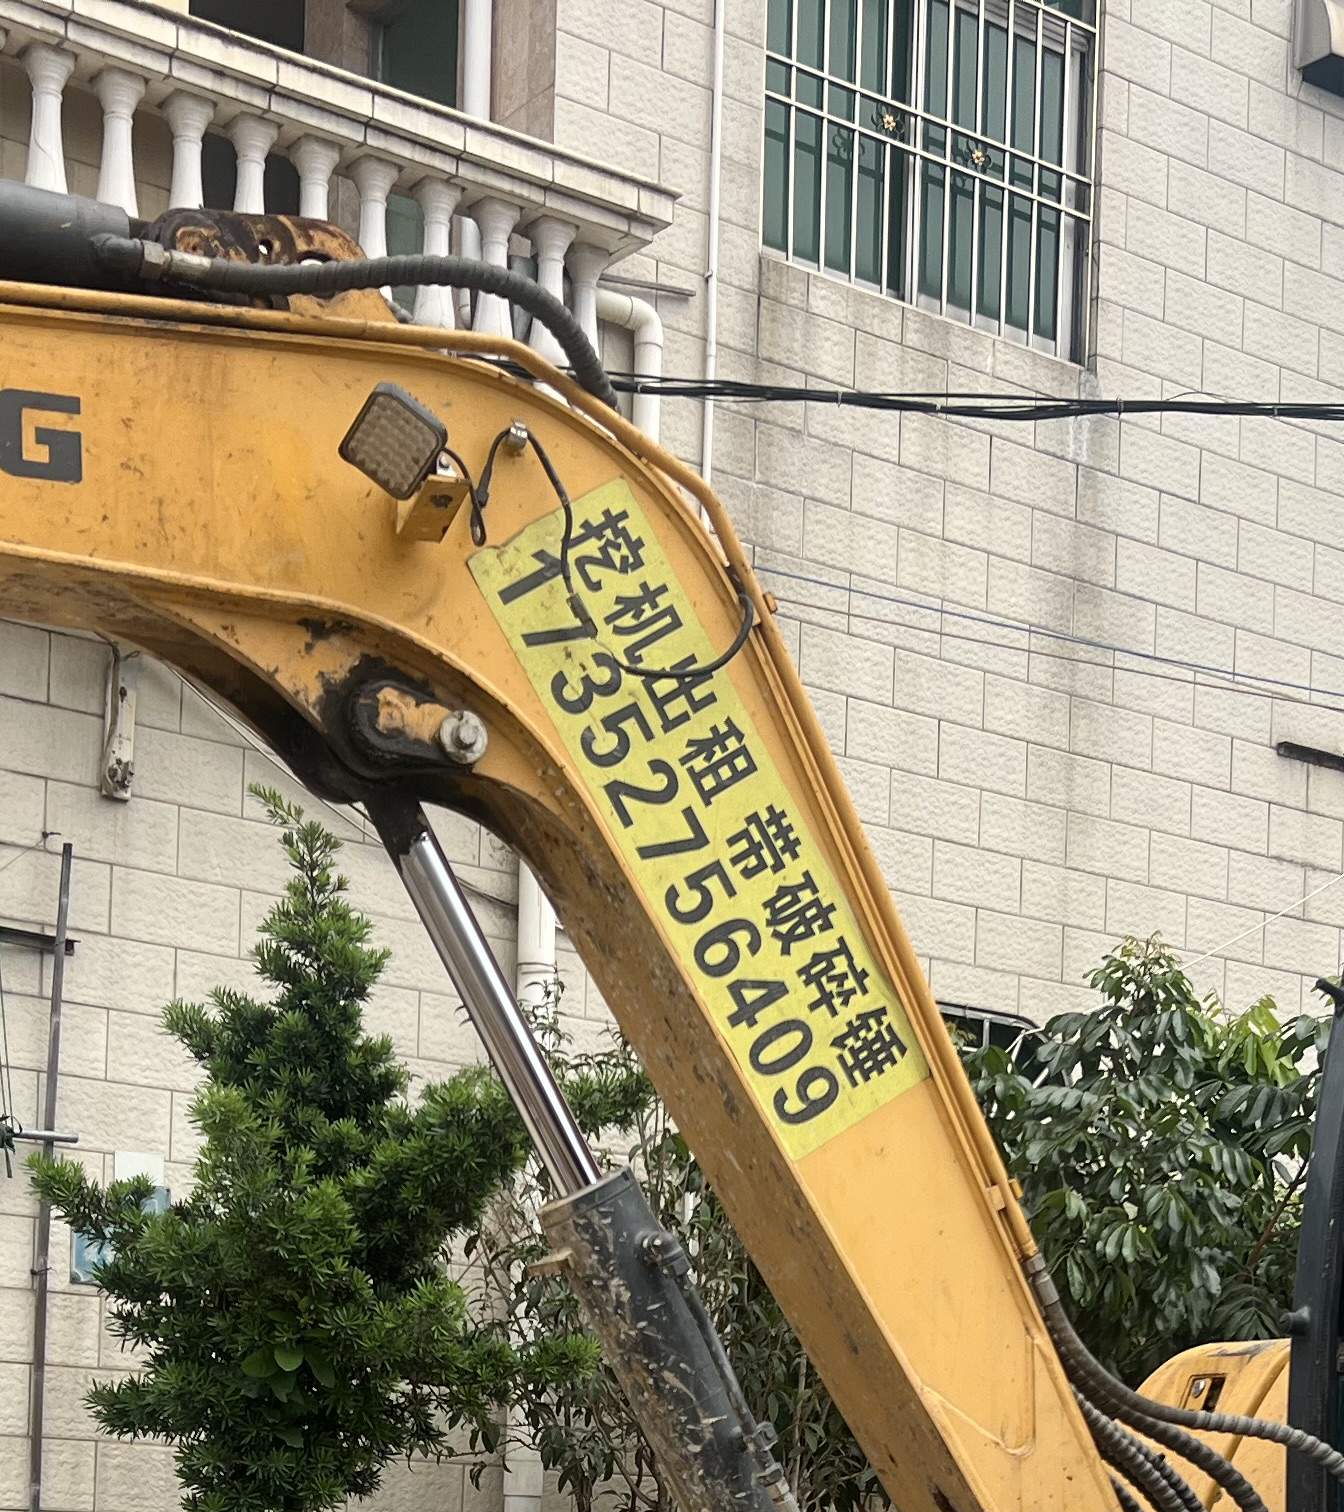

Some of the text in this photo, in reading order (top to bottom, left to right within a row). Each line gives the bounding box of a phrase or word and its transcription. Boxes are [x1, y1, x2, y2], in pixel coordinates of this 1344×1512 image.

[497, 548, 839, 1126] 17352756409
[568, 507, 908, 1089] 挖机出租 带破碎锤
